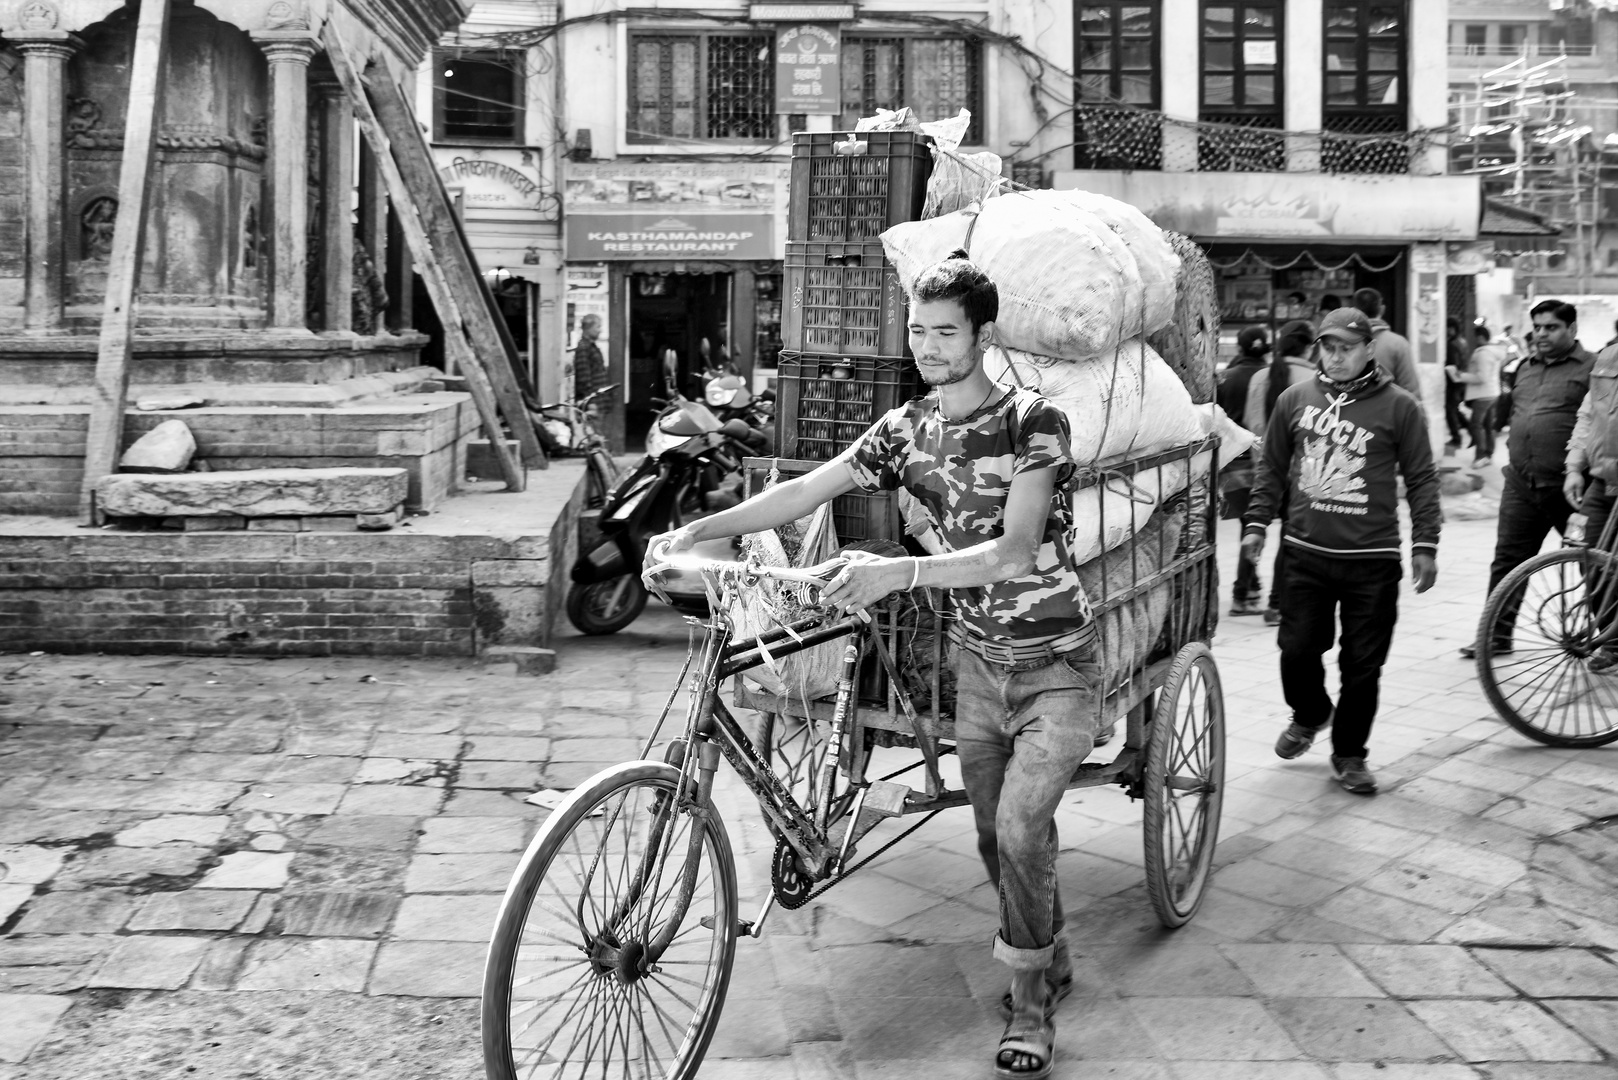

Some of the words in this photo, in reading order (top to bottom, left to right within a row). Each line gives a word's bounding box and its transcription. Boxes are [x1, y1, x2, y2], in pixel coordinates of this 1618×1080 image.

[753, 6, 815, 19] Mountain
[587, 231, 754, 243] KASTHAMANDAP
[603, 242, 739, 253] RESTAURANT
